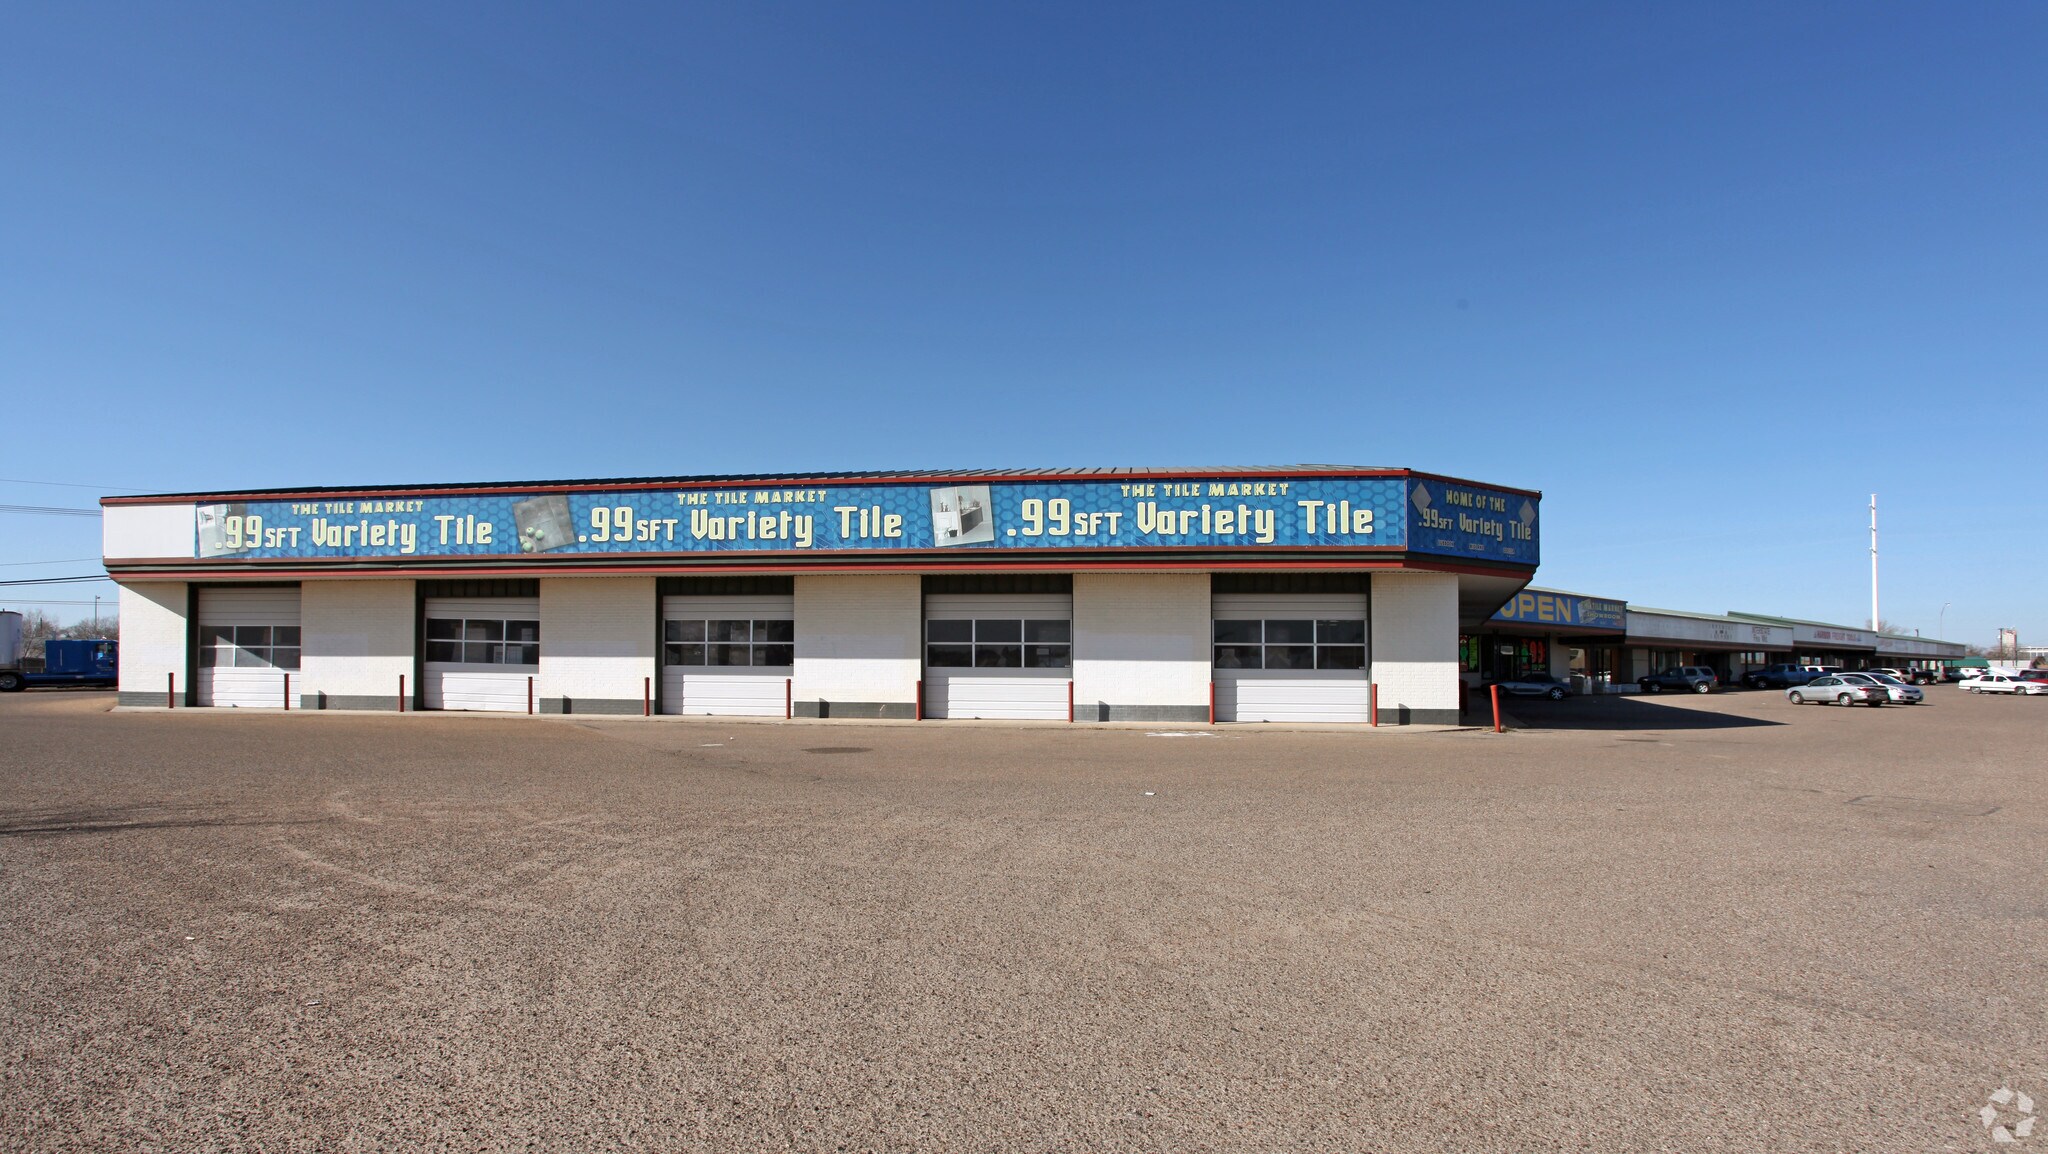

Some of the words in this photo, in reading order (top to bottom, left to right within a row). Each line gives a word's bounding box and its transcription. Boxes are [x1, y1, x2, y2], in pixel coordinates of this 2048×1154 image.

[677, 493, 708, 506] THE
[714, 491, 748, 505] TILE
[754, 489, 827, 504] MARKET
[1121, 484, 1155, 497] THE
[1163, 483, 1201, 497] TILE
[1208, 482, 1289, 496] MARKET
[1446, 489, 1472, 507] HOME
[1475, 494, 1487, 509] OF
[1489, 496, 1505, 512] THE
[292, 503, 319, 515] THE
[325, 501, 354, 515] TILE
[359, 500, 424, 514] MARKET
[1136, 499, 1275, 544] Variety
[1298, 500, 1373, 535] Tile
[312, 517, 416, 554] Variety
[434, 514, 492, 545] Tile
[690, 507, 813, 548] Variety
[833, 505, 902, 539] Tile
[1459, 512, 1503, 542] Variety
[1509, 520, 1531, 540] Tile
[1500, 593, 1572, 622] OPEN
